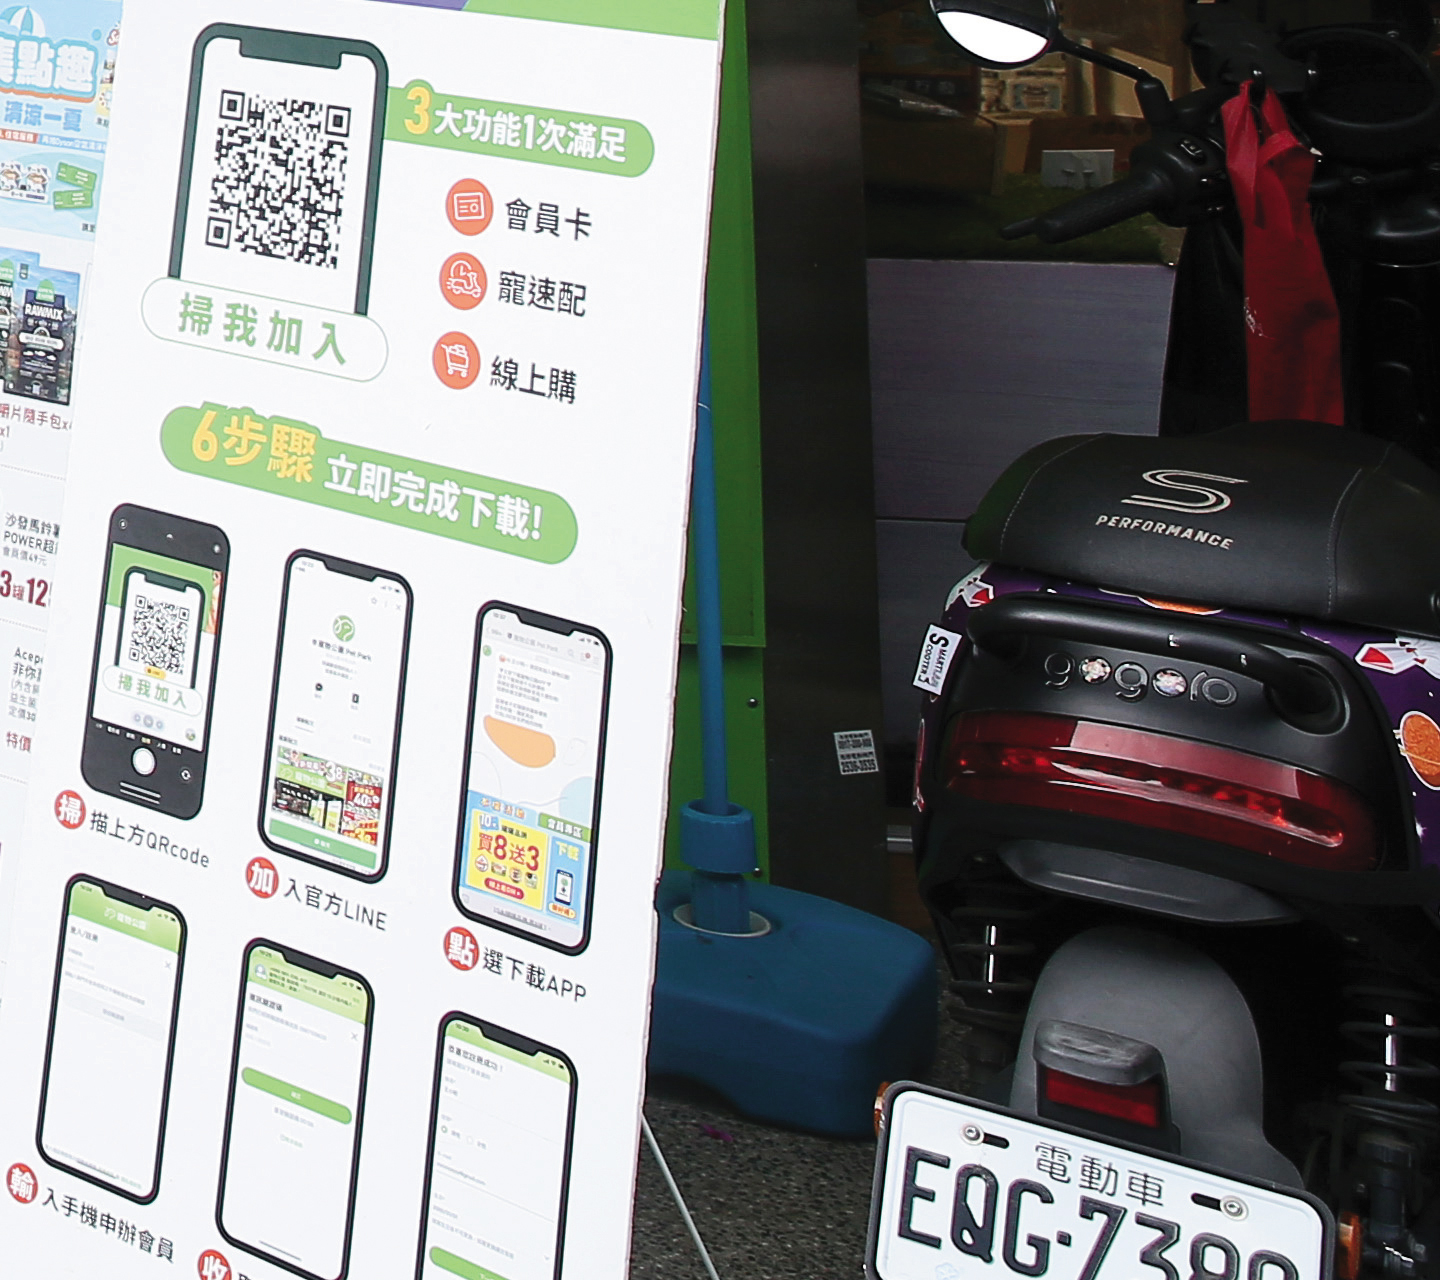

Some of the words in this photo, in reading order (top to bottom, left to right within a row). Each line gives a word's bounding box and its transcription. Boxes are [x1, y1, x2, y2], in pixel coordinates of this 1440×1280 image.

[403, 86, 628, 165] 3大功能1次滿足
[504, 196, 592, 242] 會員卡
[24, 303, 64, 322] RAWMIX
[497, 269, 587, 318] 寵速配
[177, 290, 348, 365] 掃我加入
[489, 355, 577, 405] 線上購
[191, 406, 320, 483] 6步驟
[322, 451, 545, 542] 立即完成下載!
[3, 530, 58, 555] POWER超
[1094, 514, 1235, 552] PERFORMANCE
[117, 669, 189, 710] 掃我加入
[6, 731, 32, 754] 特價
[55, 794, 84, 826] 掃
[90, 809, 211, 870] 描上方QRcode
[476, 831, 540, 872] 買8送3
[555, 840, 580, 862] 下載
[248, 860, 277, 895] 加
[282, 877, 388, 932] 入官方LINE
[445, 929, 478, 968] 點
[481, 945, 587, 1003] 選下載APP
[1033, 1141, 1167, 1208] 電動車
[9, 1166, 35, 1202] 輸
[42, 1186, 175, 1265] 入手機申辦會員
[201, 1254, 230, 1280] 收
